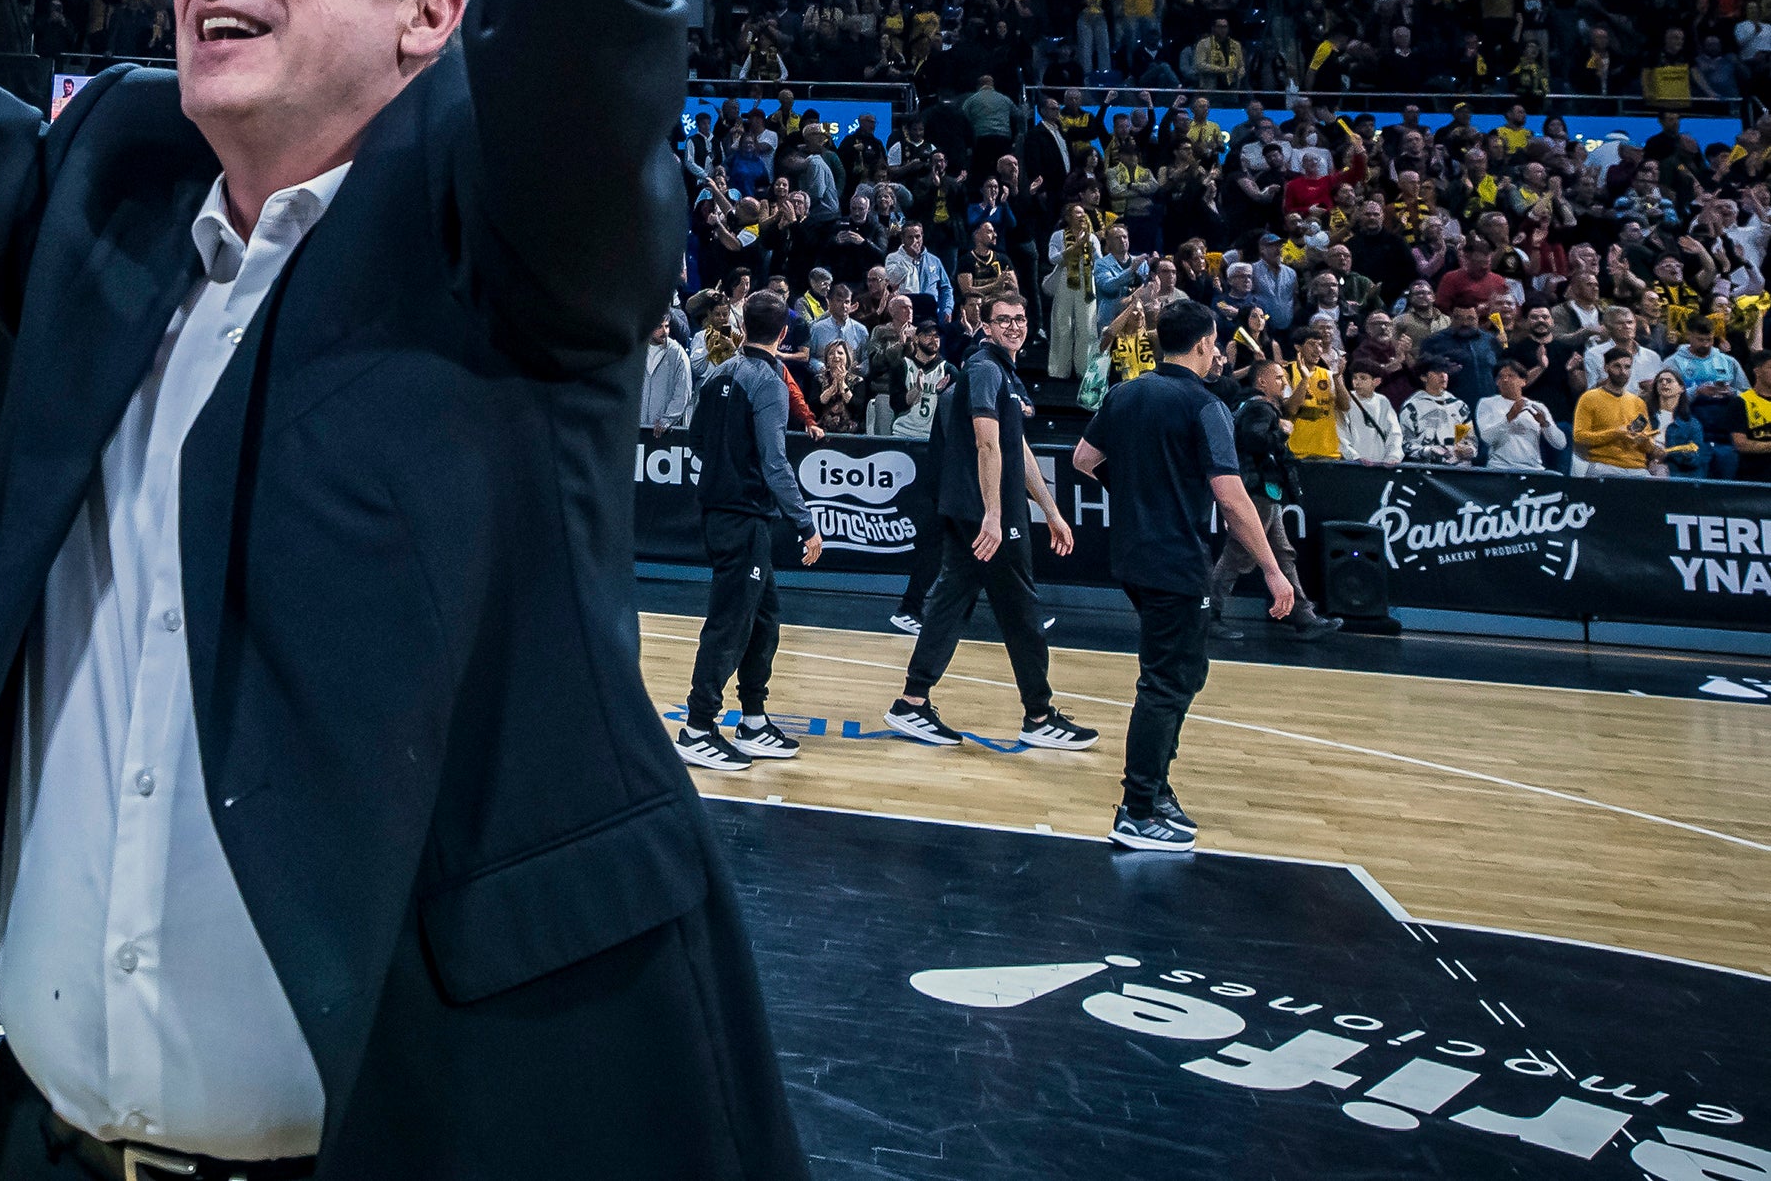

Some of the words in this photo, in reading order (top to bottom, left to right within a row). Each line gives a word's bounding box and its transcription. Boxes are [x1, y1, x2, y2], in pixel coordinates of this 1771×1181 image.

[919, 398, 931, 418] 5
[820, 460, 894, 489] isola
[1666, 513, 1771, 555] TER
[1438, 550, 1477, 565] BAKERY
[1484, 541, 1539, 558] PRODUCTS
[1669, 555, 1771, 596] YNA
